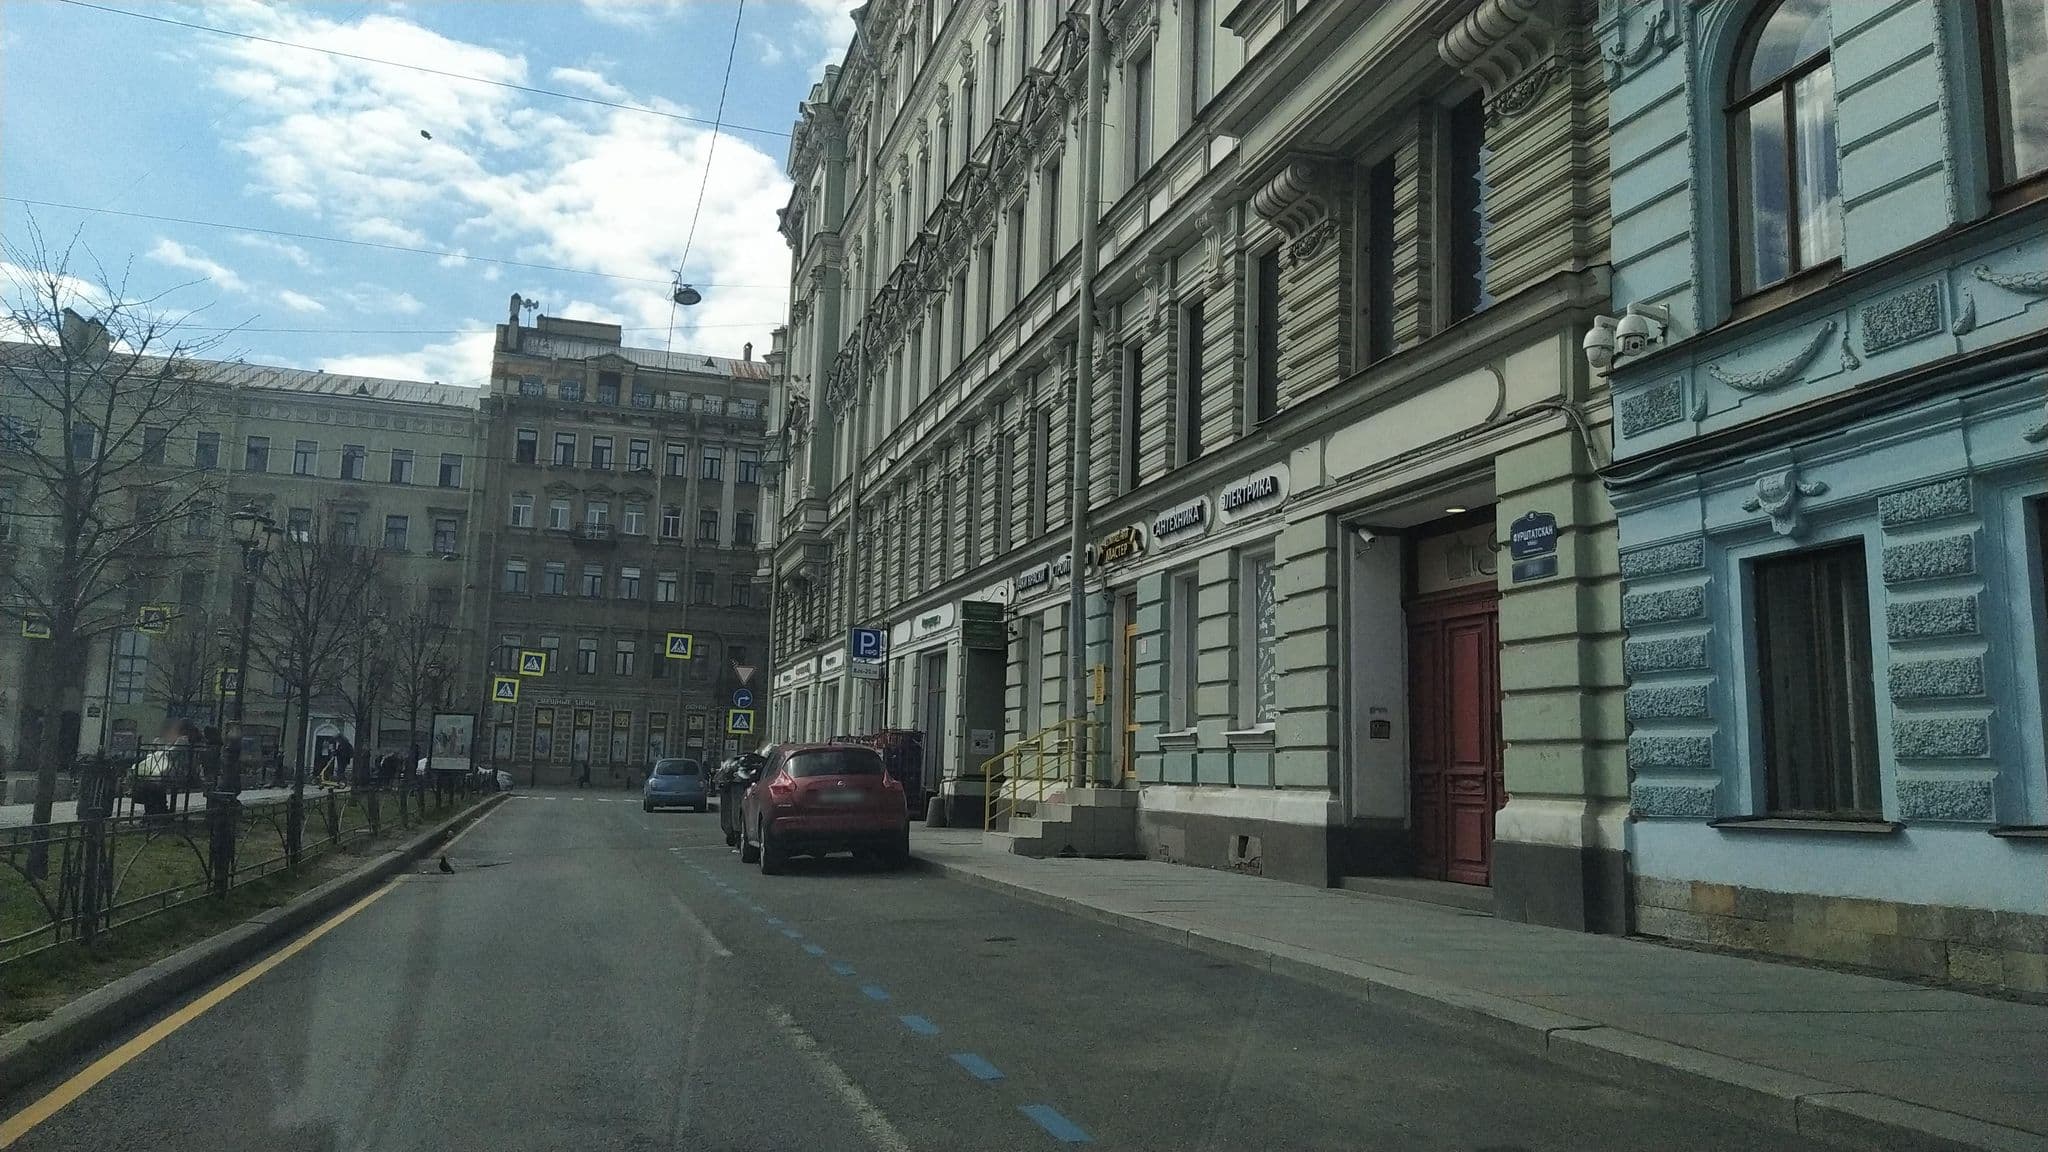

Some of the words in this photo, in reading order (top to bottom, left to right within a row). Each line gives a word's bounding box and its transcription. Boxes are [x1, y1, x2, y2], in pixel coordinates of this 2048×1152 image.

[1221, 477, 1273, 510] ЭЛЕКТРИКА
[1153, 503, 1200, 537] САНТЕХНИКА
[1513, 526, 1554, 543] ФУРШТАТСКАЯ
[1105, 543, 1128, 562] МАСТЕР
